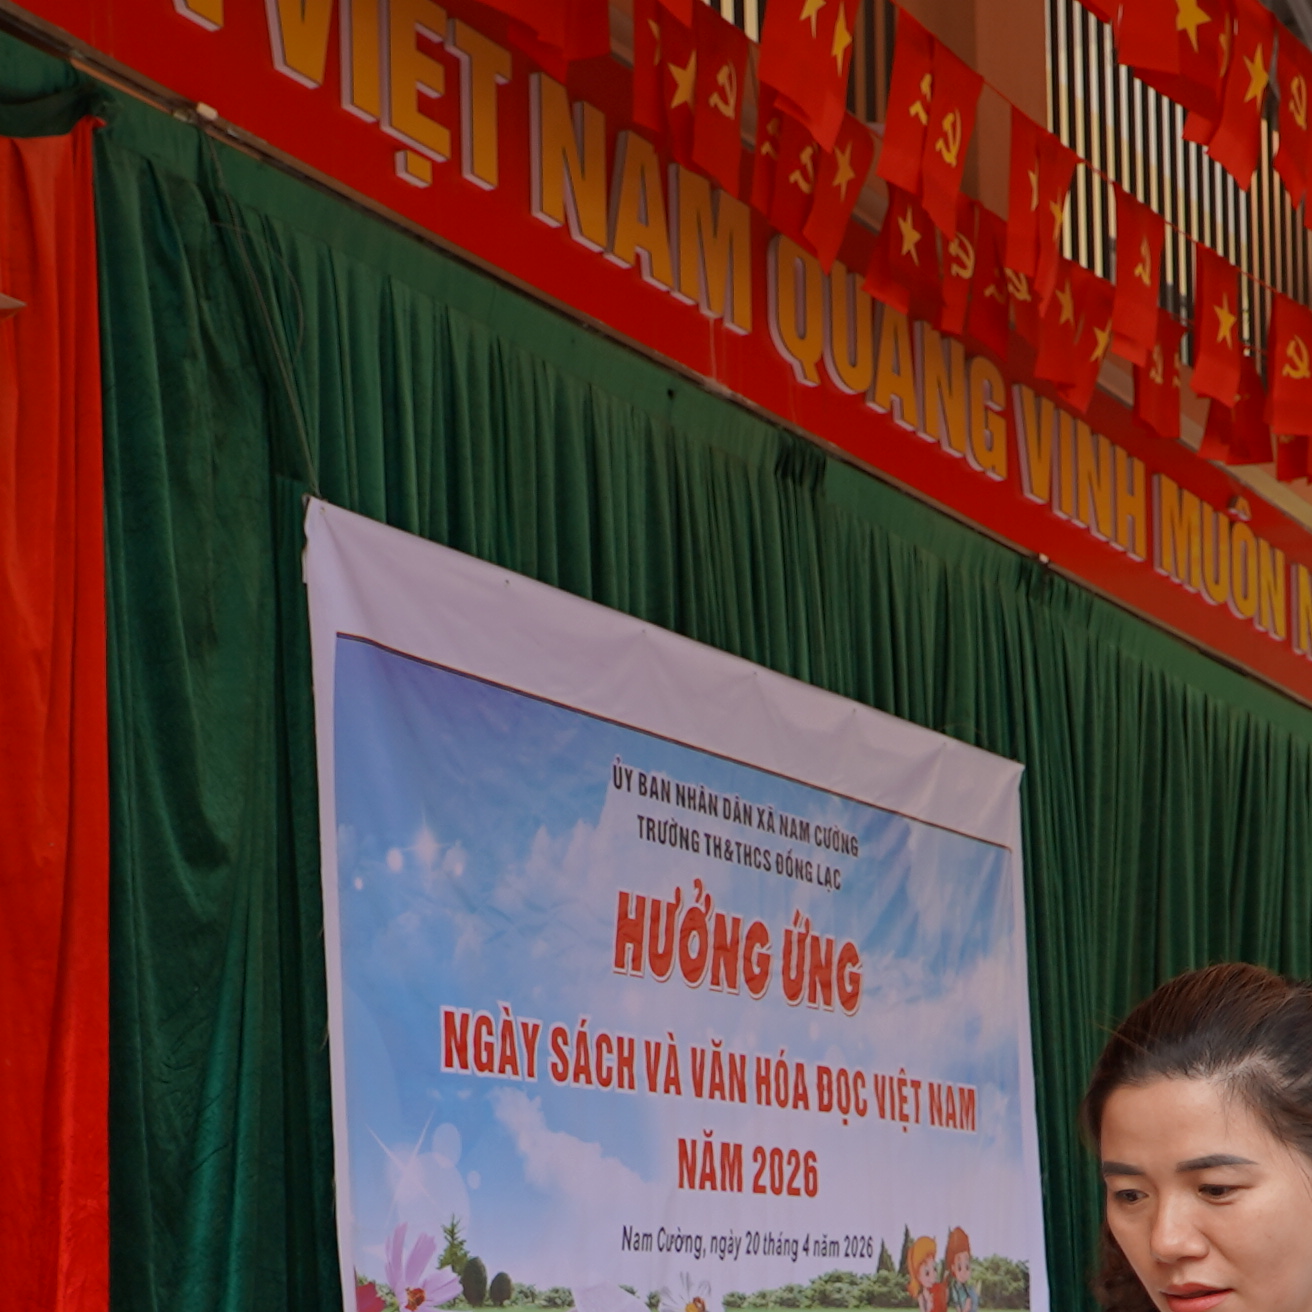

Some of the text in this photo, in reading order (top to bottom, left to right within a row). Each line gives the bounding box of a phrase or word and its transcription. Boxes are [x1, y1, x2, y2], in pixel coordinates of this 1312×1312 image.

[529, 72, 752, 335] NAM
[768, 233, 1008, 482] QUANG
[1013, 384, 1148, 562] VINH
[1152, 472, 1287, 641] MUÔN
[613, 757, 859, 857] ỦY BAN NHÂN DÂN XÃ NAM CƯỜNG
[637, 814, 700, 854] TRƯỜNG
[704, 832, 772, 872] TH&THCS
[817, 863, 841, 893] LẠC
[614, 878, 862, 1014] HƯỞNG ỨNG
[442, 1003, 978, 1134] NGÀY SÁCH VÀ VĂN HÓA ĐỌC VIỆT NAM
[677, 1128, 820, 1199] NĂM 2026
[622, 1225, 874, 1263] Nam Cường, ngày 20 tháng 4 năm 2026
